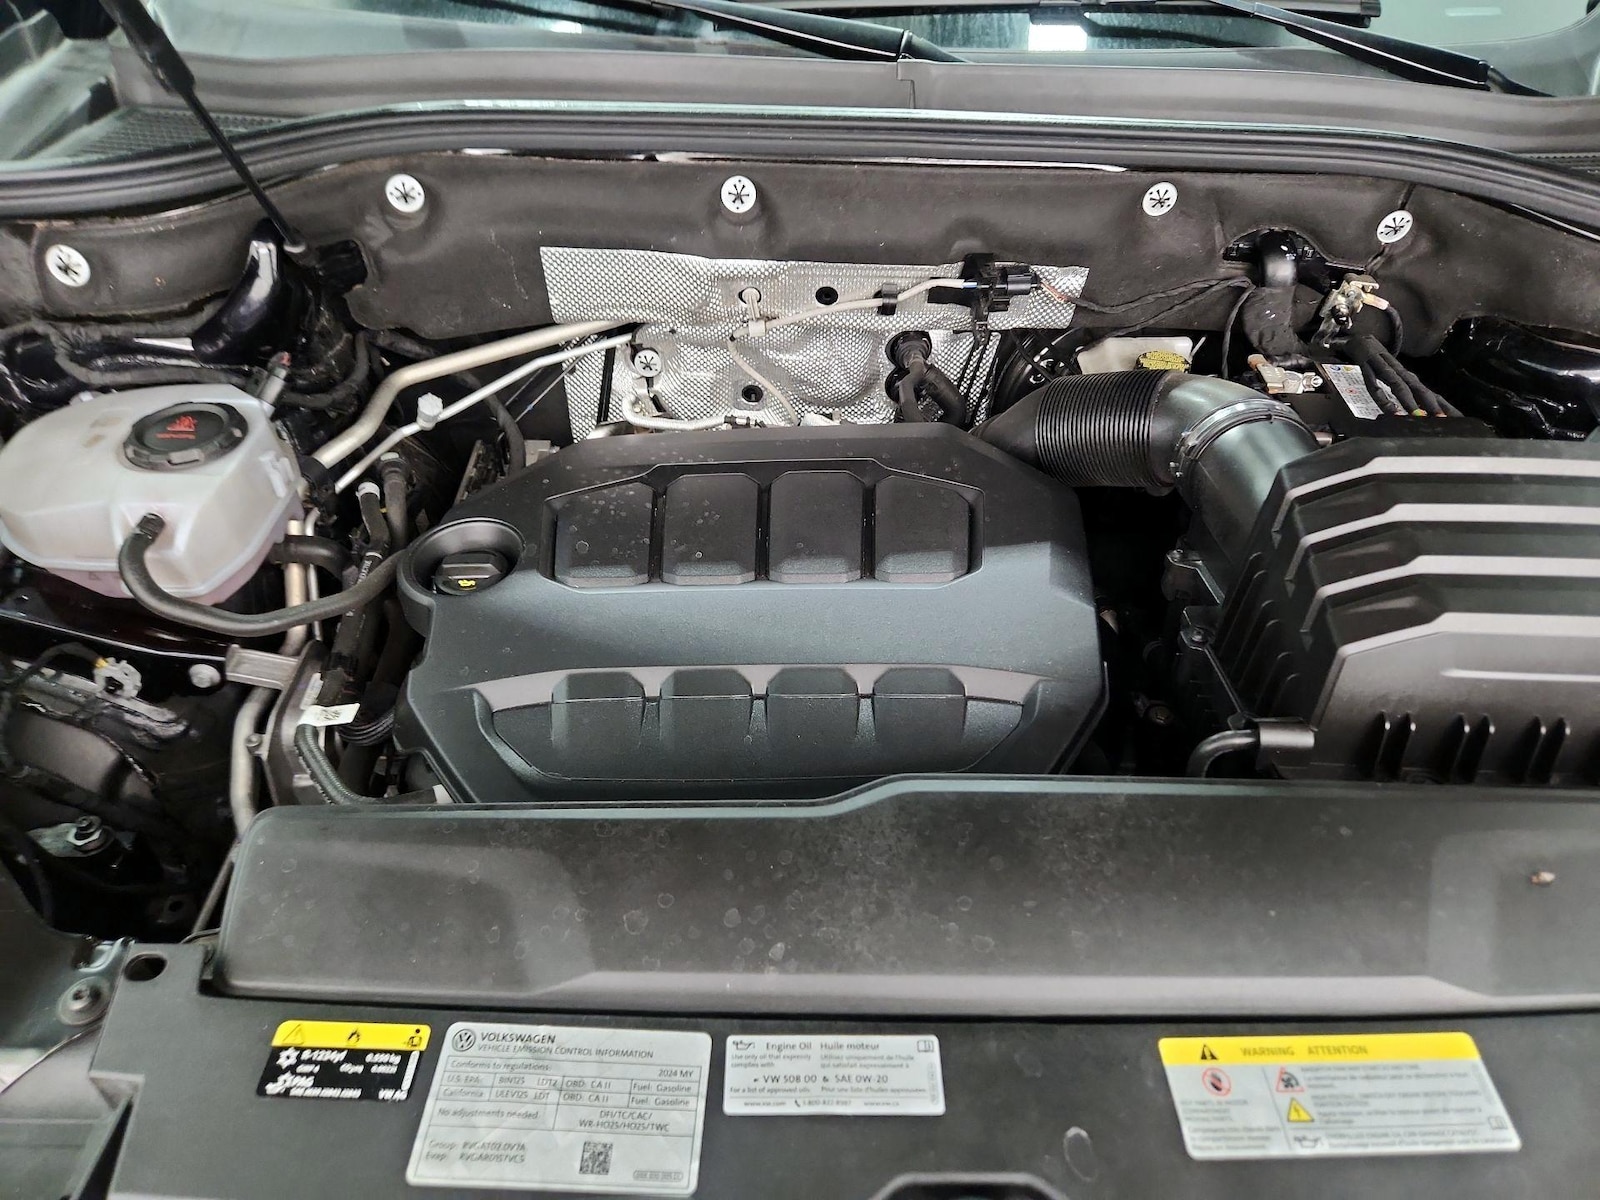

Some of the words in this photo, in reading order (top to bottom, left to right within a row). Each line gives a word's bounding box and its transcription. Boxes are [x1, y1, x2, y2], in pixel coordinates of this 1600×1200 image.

[480, 1032, 556, 1045] VOLKSWAGEN
[478, 1043, 511, 1053] VEHICLE
[513, 1044, 553, 1055] EMISSION
[554, 1046, 592, 1057] CONTROL
[595, 1048, 654, 1060] INFORMATION
[766, 1042, 797, 1053] Engine
[799, 1042, 812, 1050] Oil
[820, 1042, 846, 1050] Huile
[847, 1043, 880, 1051] moteur
[1240, 1046, 1296, 1057] WARNING
[1307, 1045, 1369, 1057] ATTENTION
[450, 1059, 491, 1070] Conforms
[492, 1061, 501, 1070] to
[658, 1068, 678, 1078] 2024
[680, 1070, 694, 1079] MY
[590, 1080, 603, 1089] CA
[763, 1075, 780, 1083] VW
[783, 1075, 802, 1084] 508
[803, 1075, 817, 1083] 00
[834, 1075, 852, 1083] SAE
[632, 1082, 652, 1092] Fuel:
[655, 1084, 692, 1094] Gasoline
[588, 1093, 601, 1103] CA
[631, 1096, 650, 1105] Fuel:
[654, 1097, 690, 1107] Gasoline
[438, 1107, 450, 1117] No
[451, 1108, 505, 1119] adjustments
[599, 1110, 653, 1120] DFI/TC/CAC/
